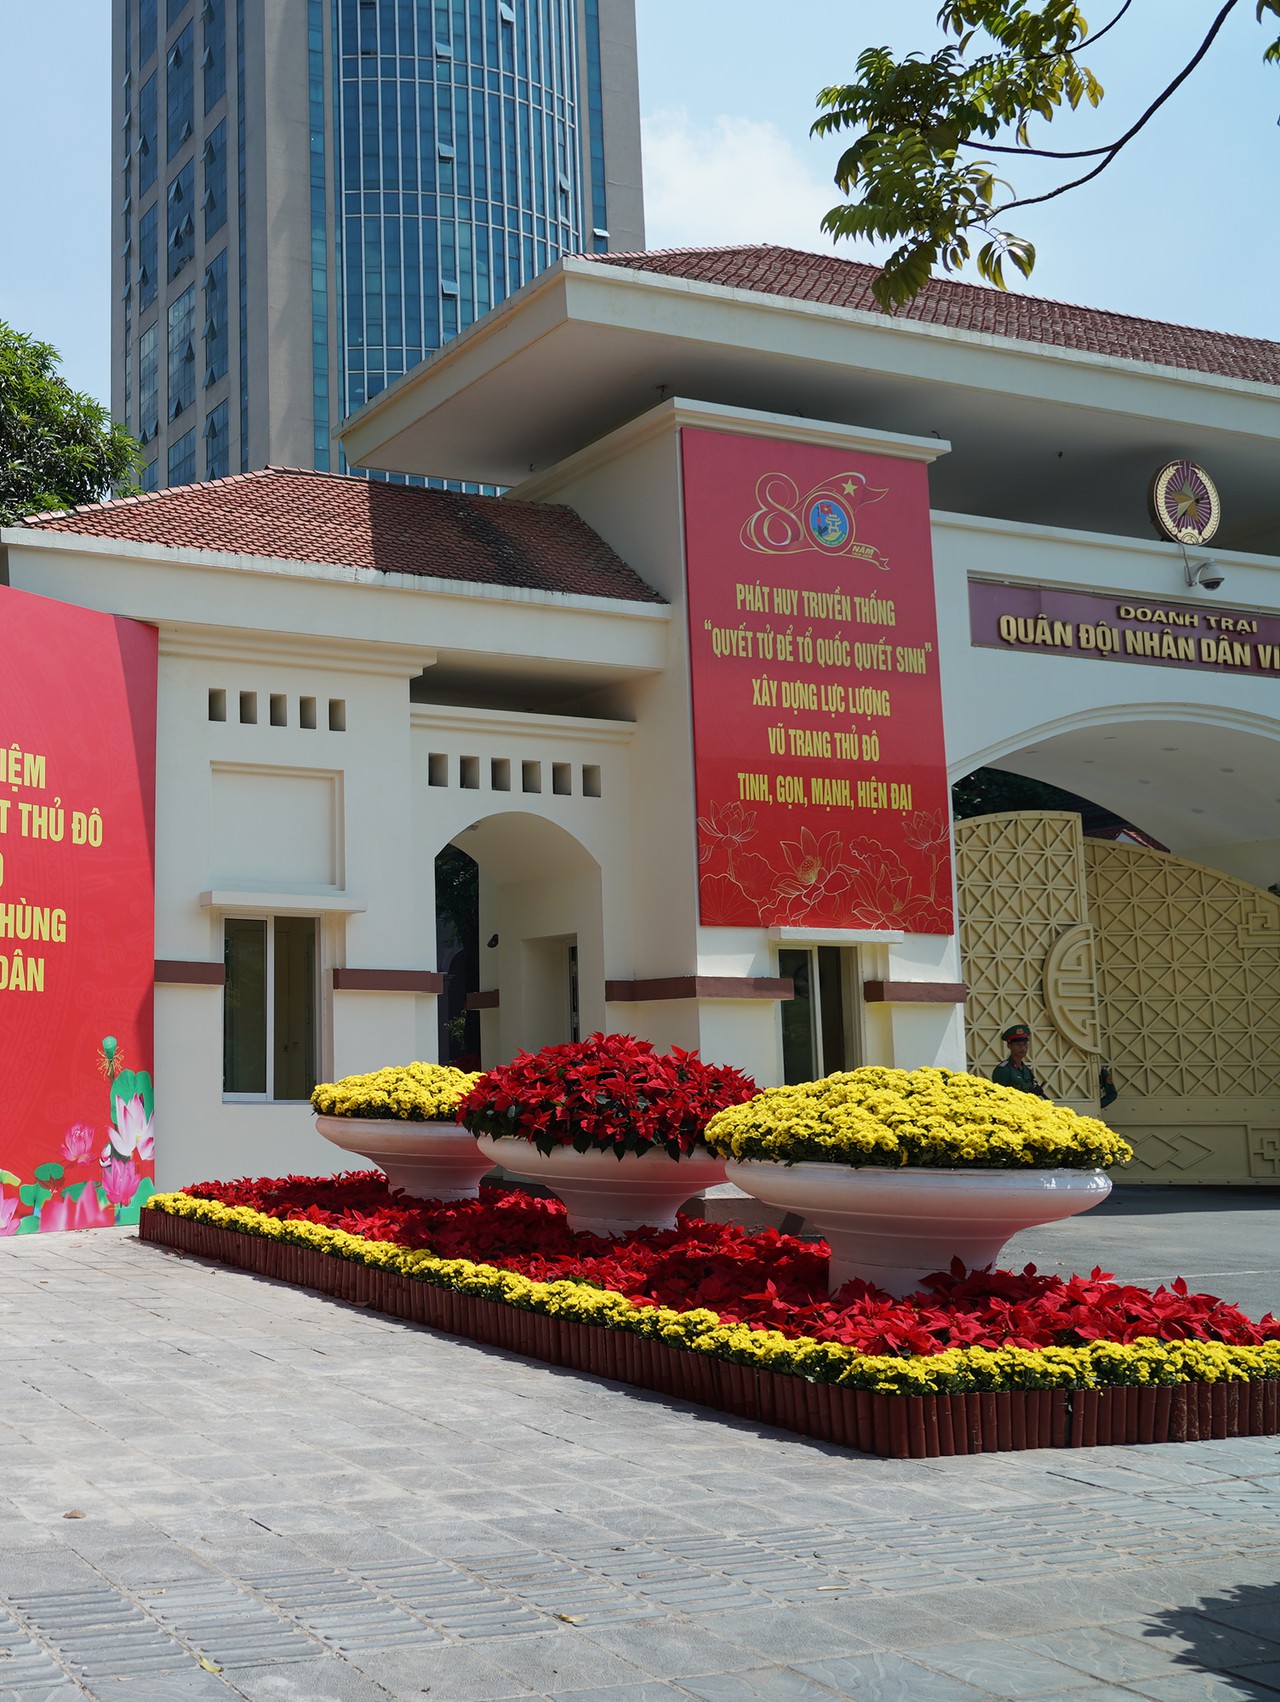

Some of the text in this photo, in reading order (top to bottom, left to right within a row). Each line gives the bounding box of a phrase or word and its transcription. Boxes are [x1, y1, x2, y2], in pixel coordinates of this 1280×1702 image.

[736, 580, 896, 626] PHÁT HUY TRUYỀN THỐNG
[1121, 607, 1257, 634] DOANH TRẠI
[704, 621, 932, 674] “QUYẾT TỬ ĐỂ TỔ QUỐC QUYẾT SINH”
[1000, 615, 1280, 670] QUÂN ĐỘI NHÂN DÂN VI
[752, 674, 890, 720] XÂY DỤNG LỰC LƯỢNG
[768, 723, 880, 761] VŨ TRANG THỦ ĐÔ
[738, 773, 912, 816] TINH, GỌN, MẠNH, HIỆN ĐẠI
[18, 797, 64, 841] THỦ
[72, 808, 102, 847] ĐÔ
[0, 898, 66, 942] HÙNG
